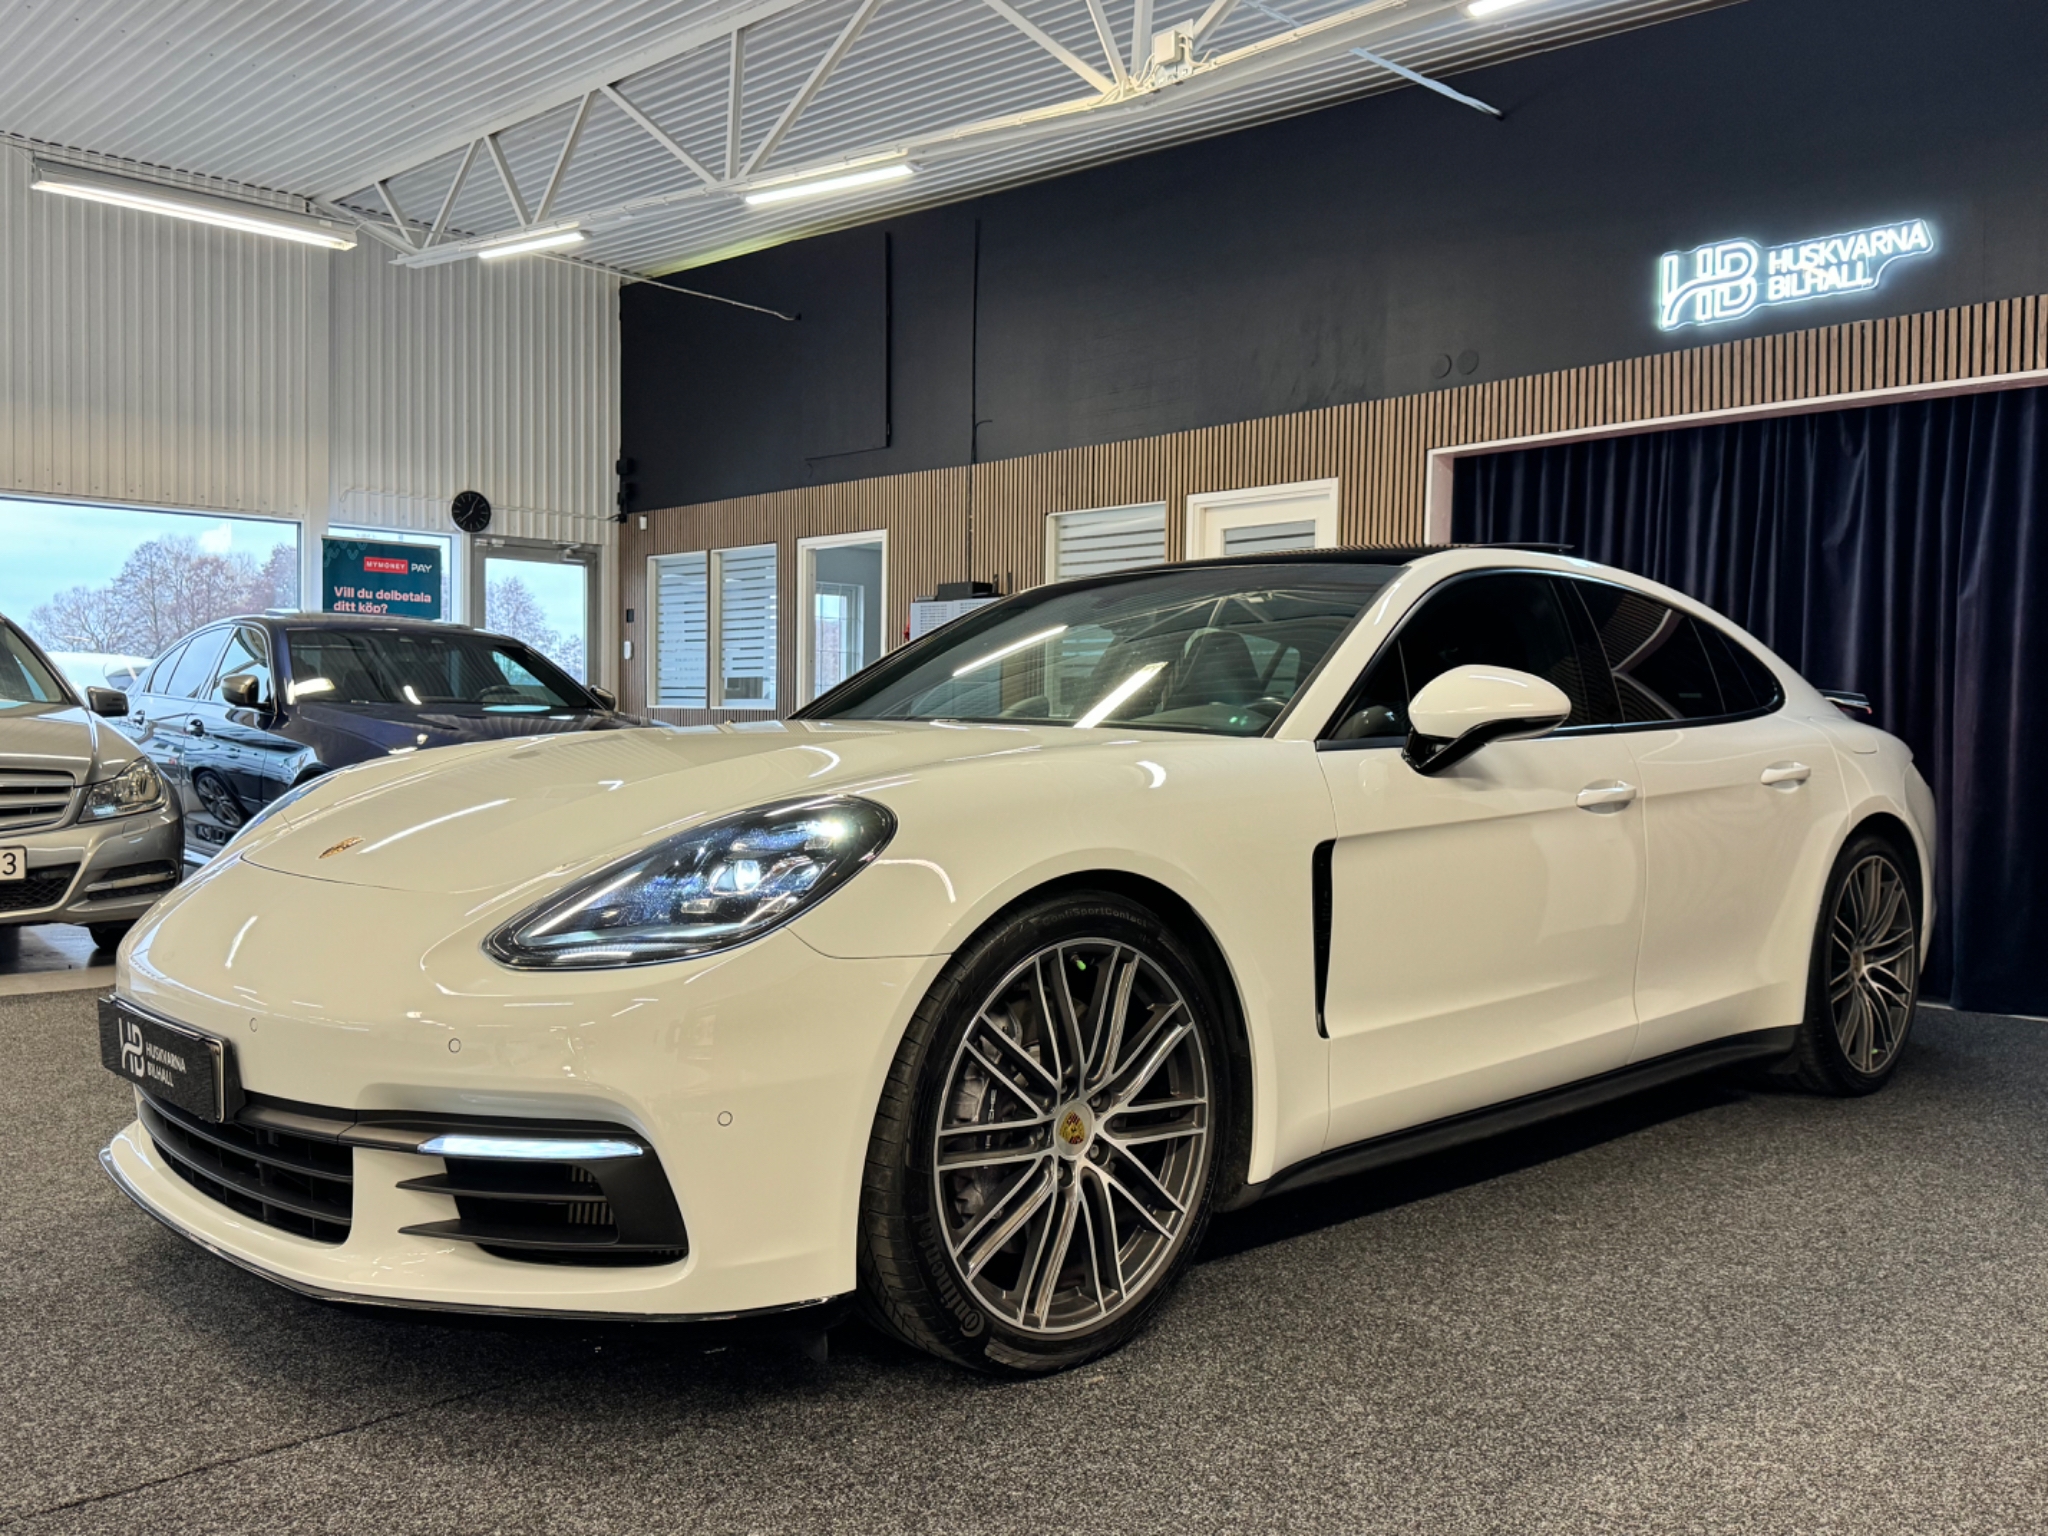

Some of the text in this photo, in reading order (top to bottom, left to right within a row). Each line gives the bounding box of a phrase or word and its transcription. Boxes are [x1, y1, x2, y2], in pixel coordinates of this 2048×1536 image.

[1768, 221, 1927, 275] HUSKVARNA
[1767, 262, 1873, 300] BILHALL
[366, 560, 432, 573] MYMONEY PAY
[333, 586, 432, 603] Vill du delbetala
[333, 601, 356, 612] ditt
[2, 852, 17, 876] 3
[145, 1041, 187, 1074] HUSKVARNA
[147, 1061, 174, 1088] BILHALL
